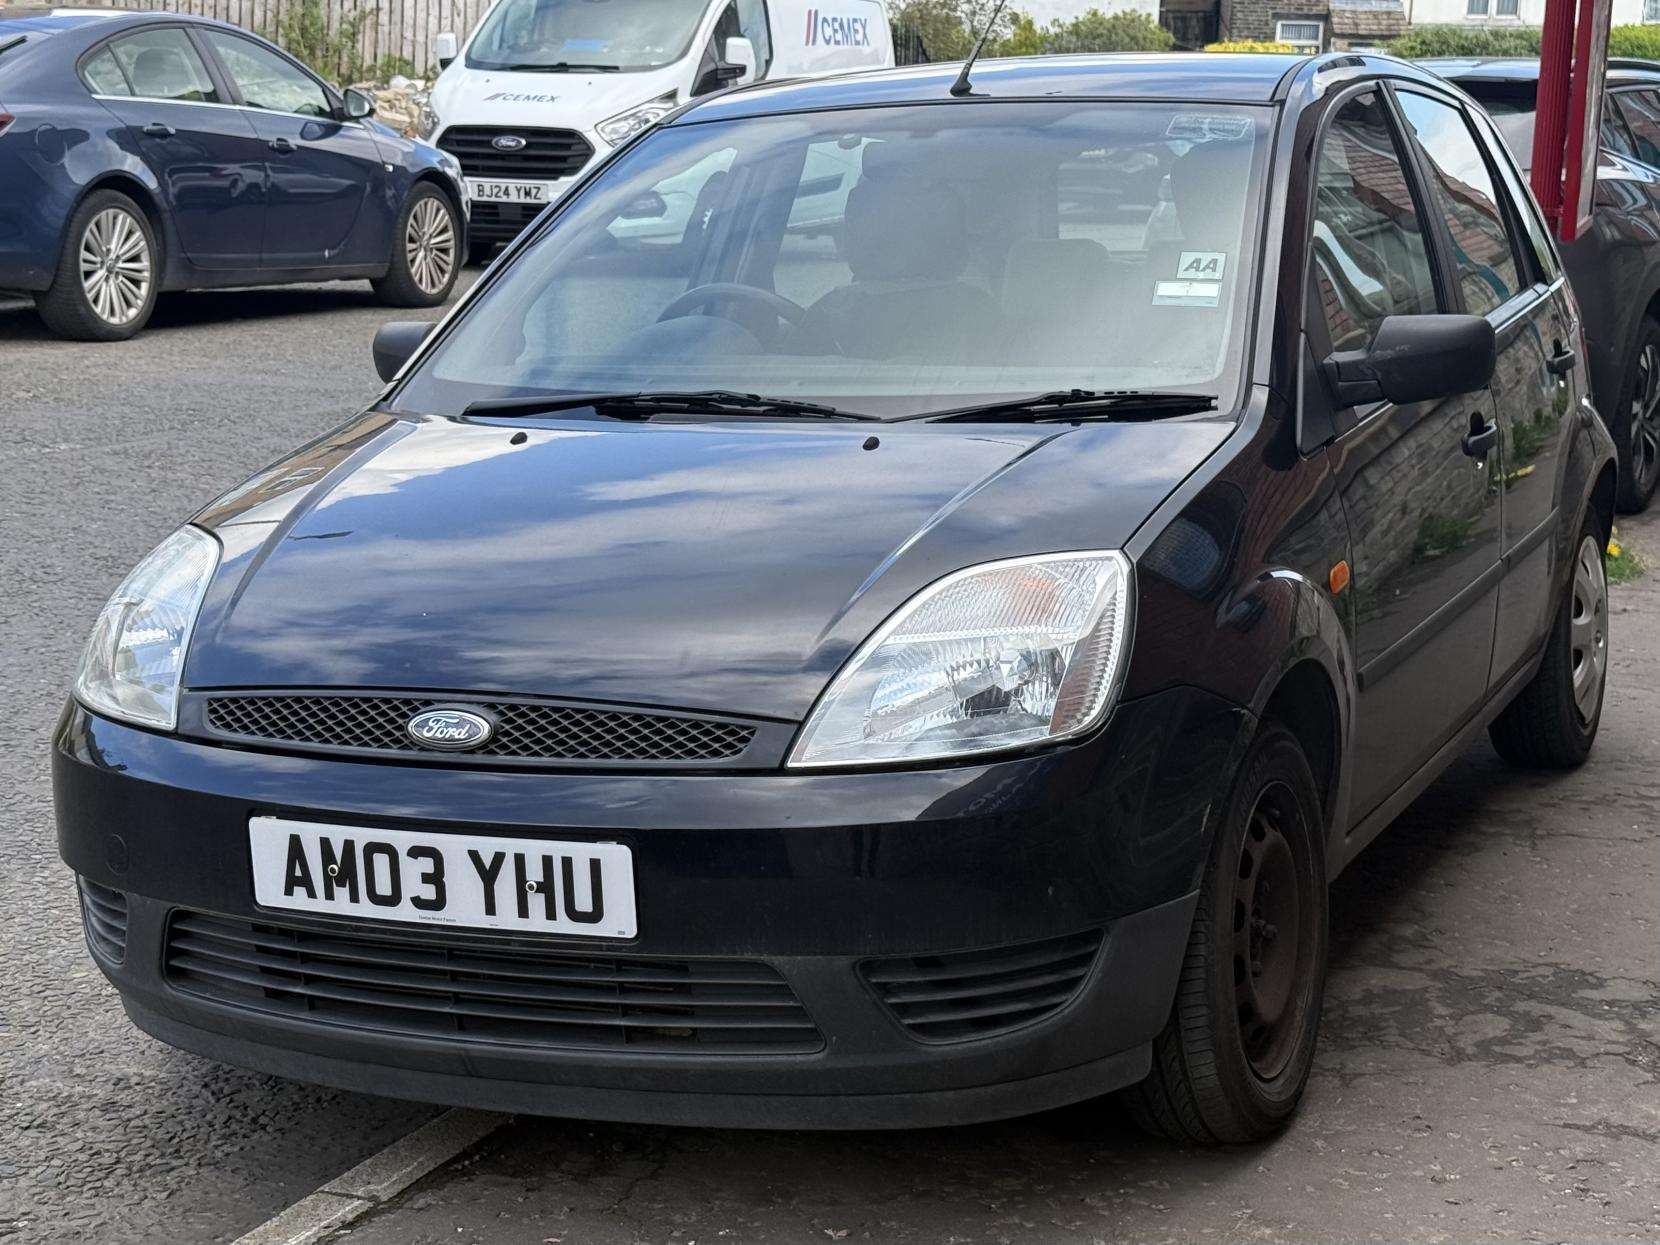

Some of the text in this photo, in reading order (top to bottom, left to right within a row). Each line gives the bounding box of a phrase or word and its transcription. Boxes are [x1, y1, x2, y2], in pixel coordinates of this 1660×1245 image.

[821, 17, 870, 47] CEMEX
[502, 93, 561, 103] CEMEX
[477, 184, 541, 200] BJ24 YMZ
[1184, 258, 1219, 272] AA
[423, 717, 471, 739] Ford
[284, 833, 605, 924] AM03 YHU
